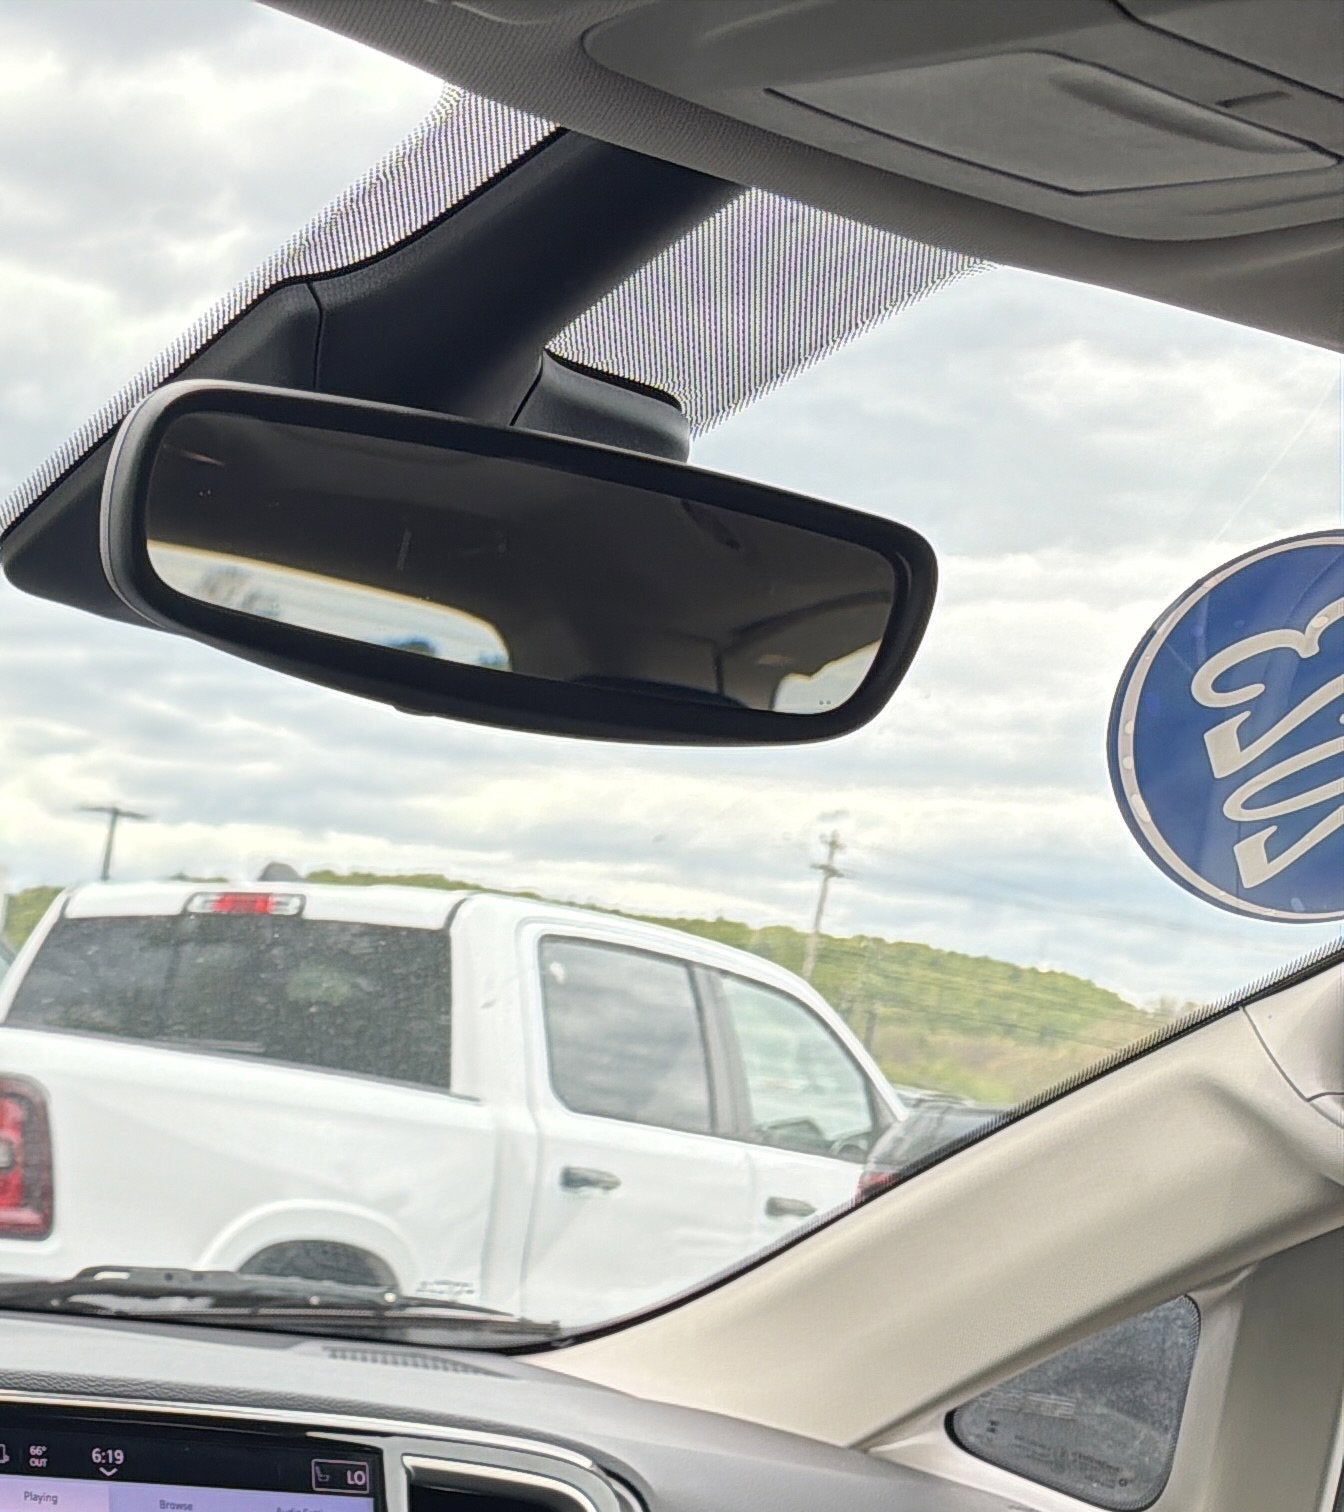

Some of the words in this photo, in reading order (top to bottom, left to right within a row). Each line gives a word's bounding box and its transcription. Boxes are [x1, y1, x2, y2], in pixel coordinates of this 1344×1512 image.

[29, 1445, 47, 1456] 66°
[91, 1447, 124, 1464] 6:19
[29, 1456, 48, 1467] OUT
[346, 1470, 366, 1486] LO
[23, 1491, 58, 1505] Playing
[159, 1499, 193, 1512] Browse
